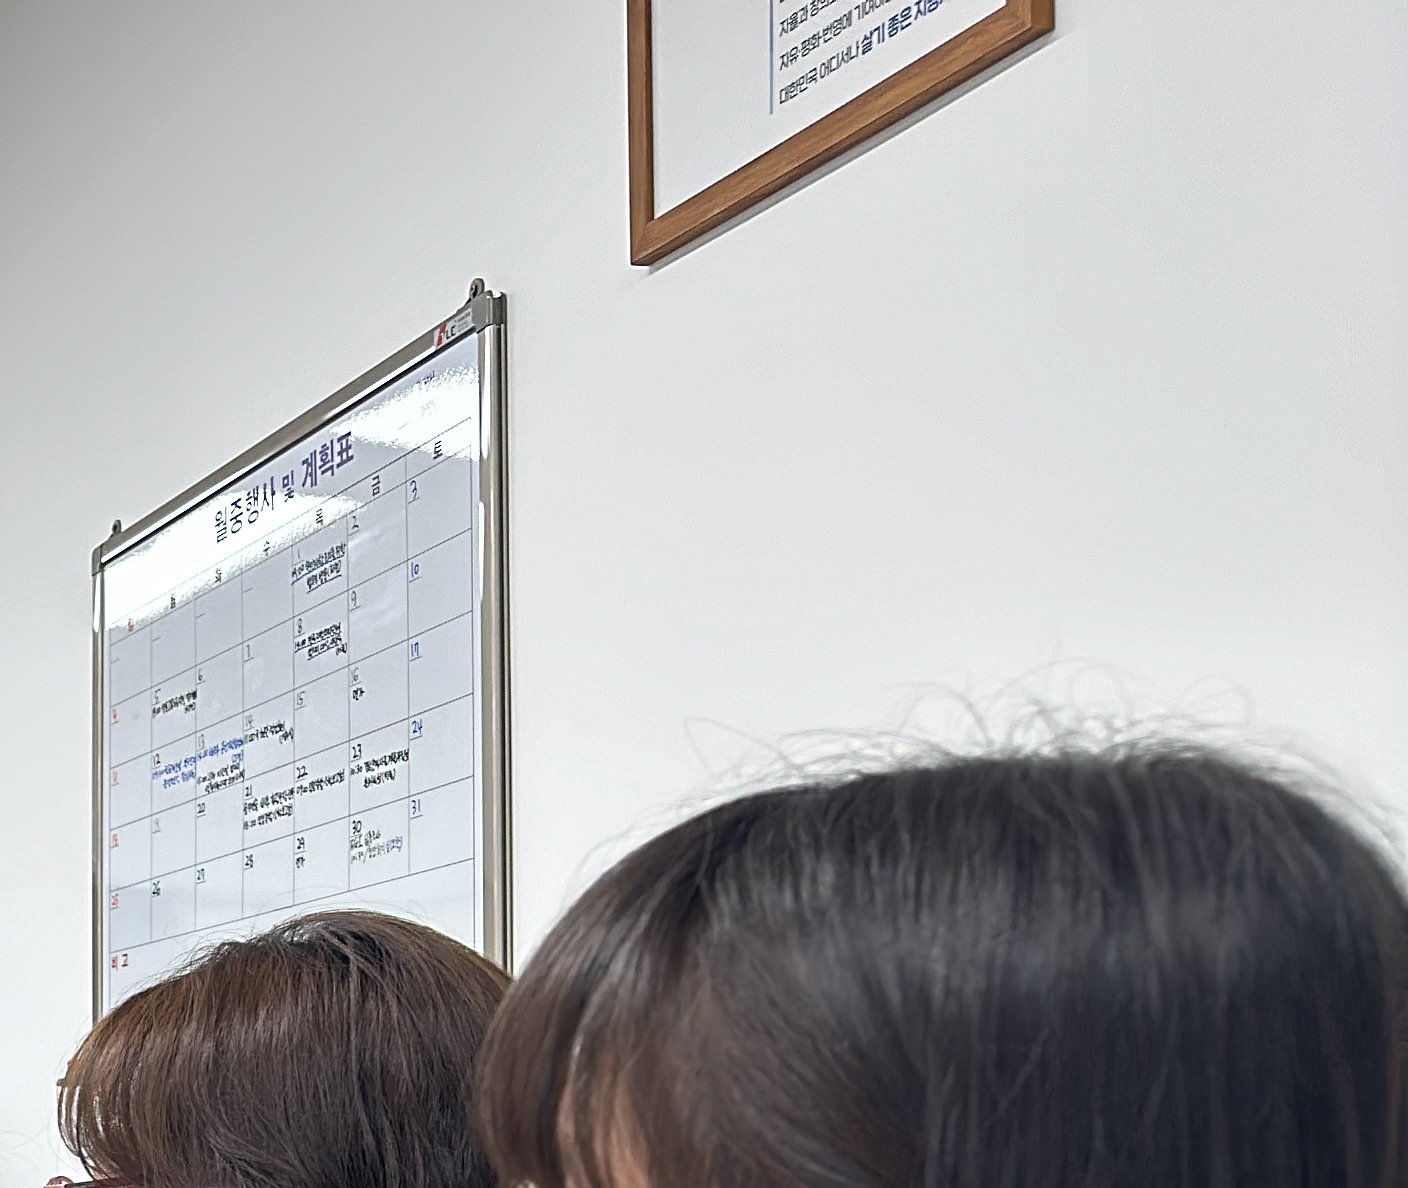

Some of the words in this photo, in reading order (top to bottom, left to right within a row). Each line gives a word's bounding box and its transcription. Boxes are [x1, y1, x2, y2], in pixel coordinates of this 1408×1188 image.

[779, 7, 809, 37] 자율과
[779, 68, 818, 104] 대한민국
[819, 45, 860, 80] 어디서나
[861, 22, 885, 56] 살기
[887, 9, 912, 39] 좋은
[214, 476, 276, 543] 월중행사
[282, 470, 295, 502] 및
[301, 431, 354, 488] 계획표
[262, 540, 271, 558] 수
[315, 508, 324, 527] 목
[371, 475, 381, 497] 금
[434, 440, 442, 460] 토
[352, 515, 359, 530] 2
[409, 480, 420, 500] 3
[411, 562, 420, 577] 10
[153, 753, 161, 766] 12
[197, 803, 206, 814] 20
[245, 785, 253, 798] 21
[296, 765, 308, 779] 22
[352, 744, 362, 759] 23
[411, 719, 423, 736] 24
[297, 837, 305, 849] 29
[352, 820, 362, 834] 30
[411, 799, 421, 815] 31
